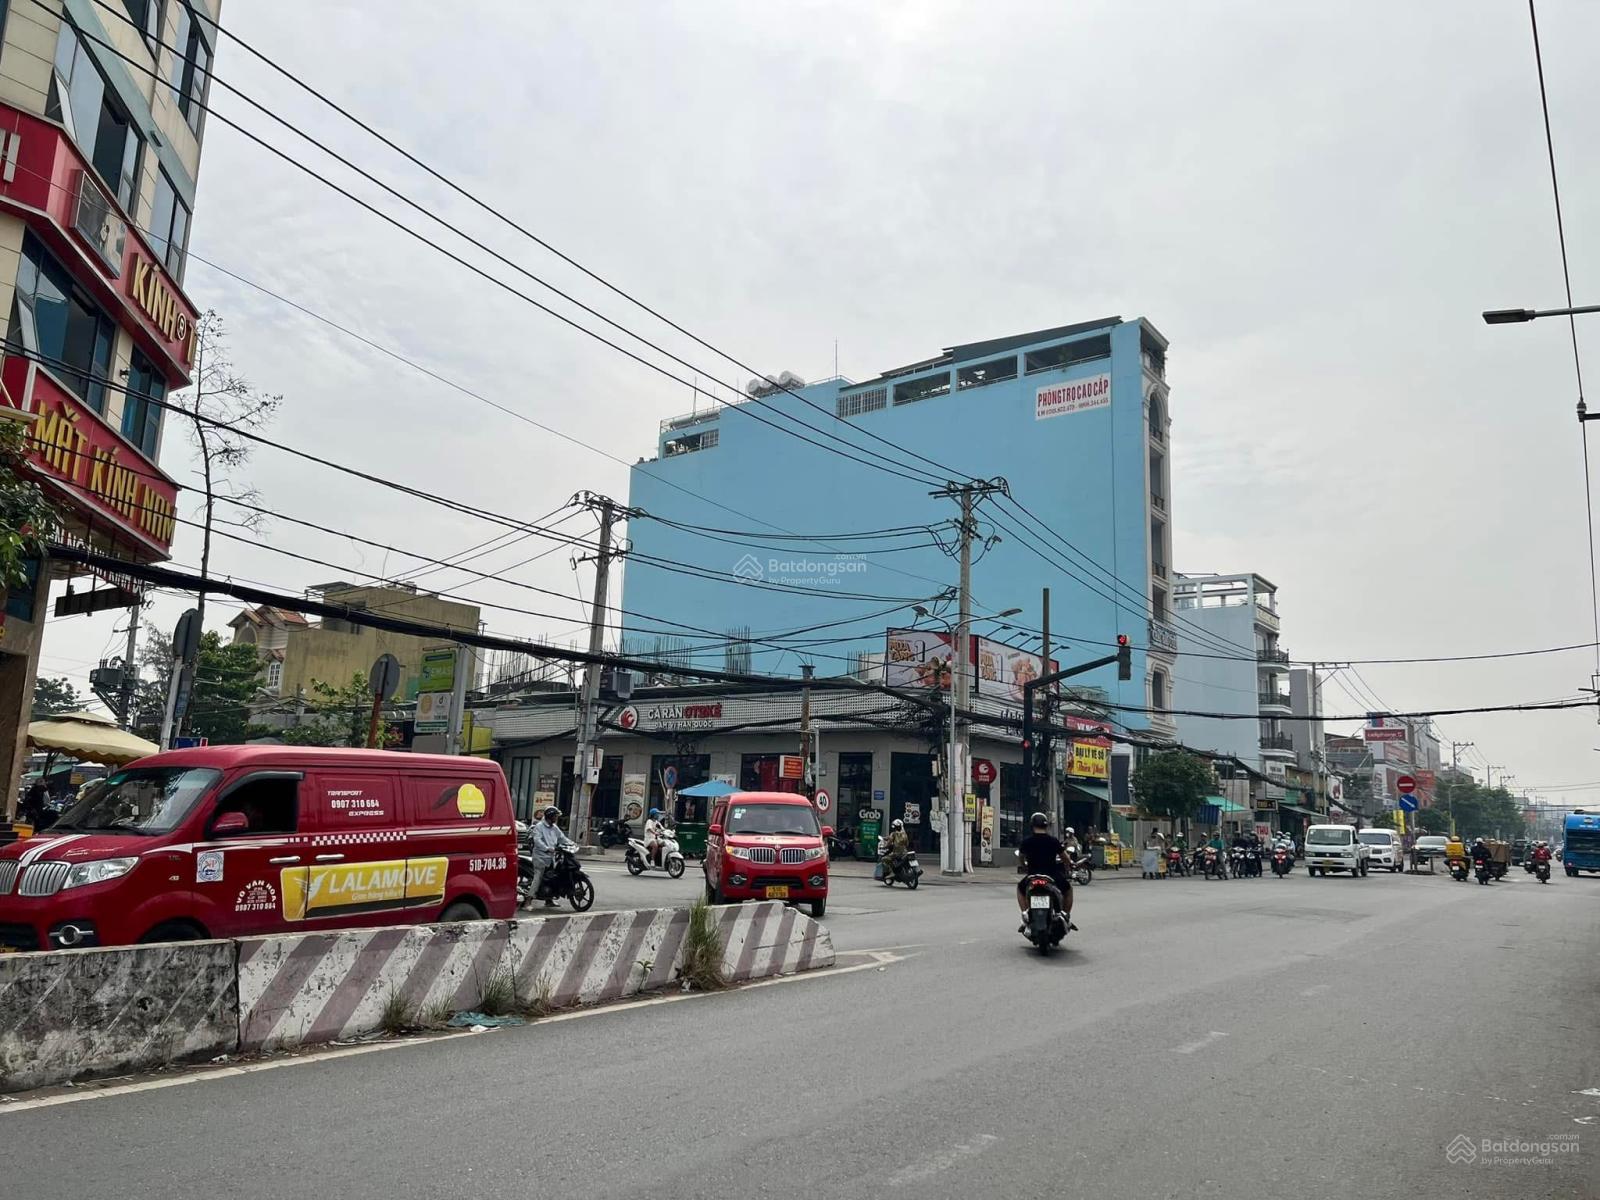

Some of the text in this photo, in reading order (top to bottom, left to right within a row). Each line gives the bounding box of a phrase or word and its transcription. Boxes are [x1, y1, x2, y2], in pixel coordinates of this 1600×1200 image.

[819, 795, 828, 808] 40
[859, 809, 881, 820] Grab
[328, 866, 437, 894] LALAMOVE
